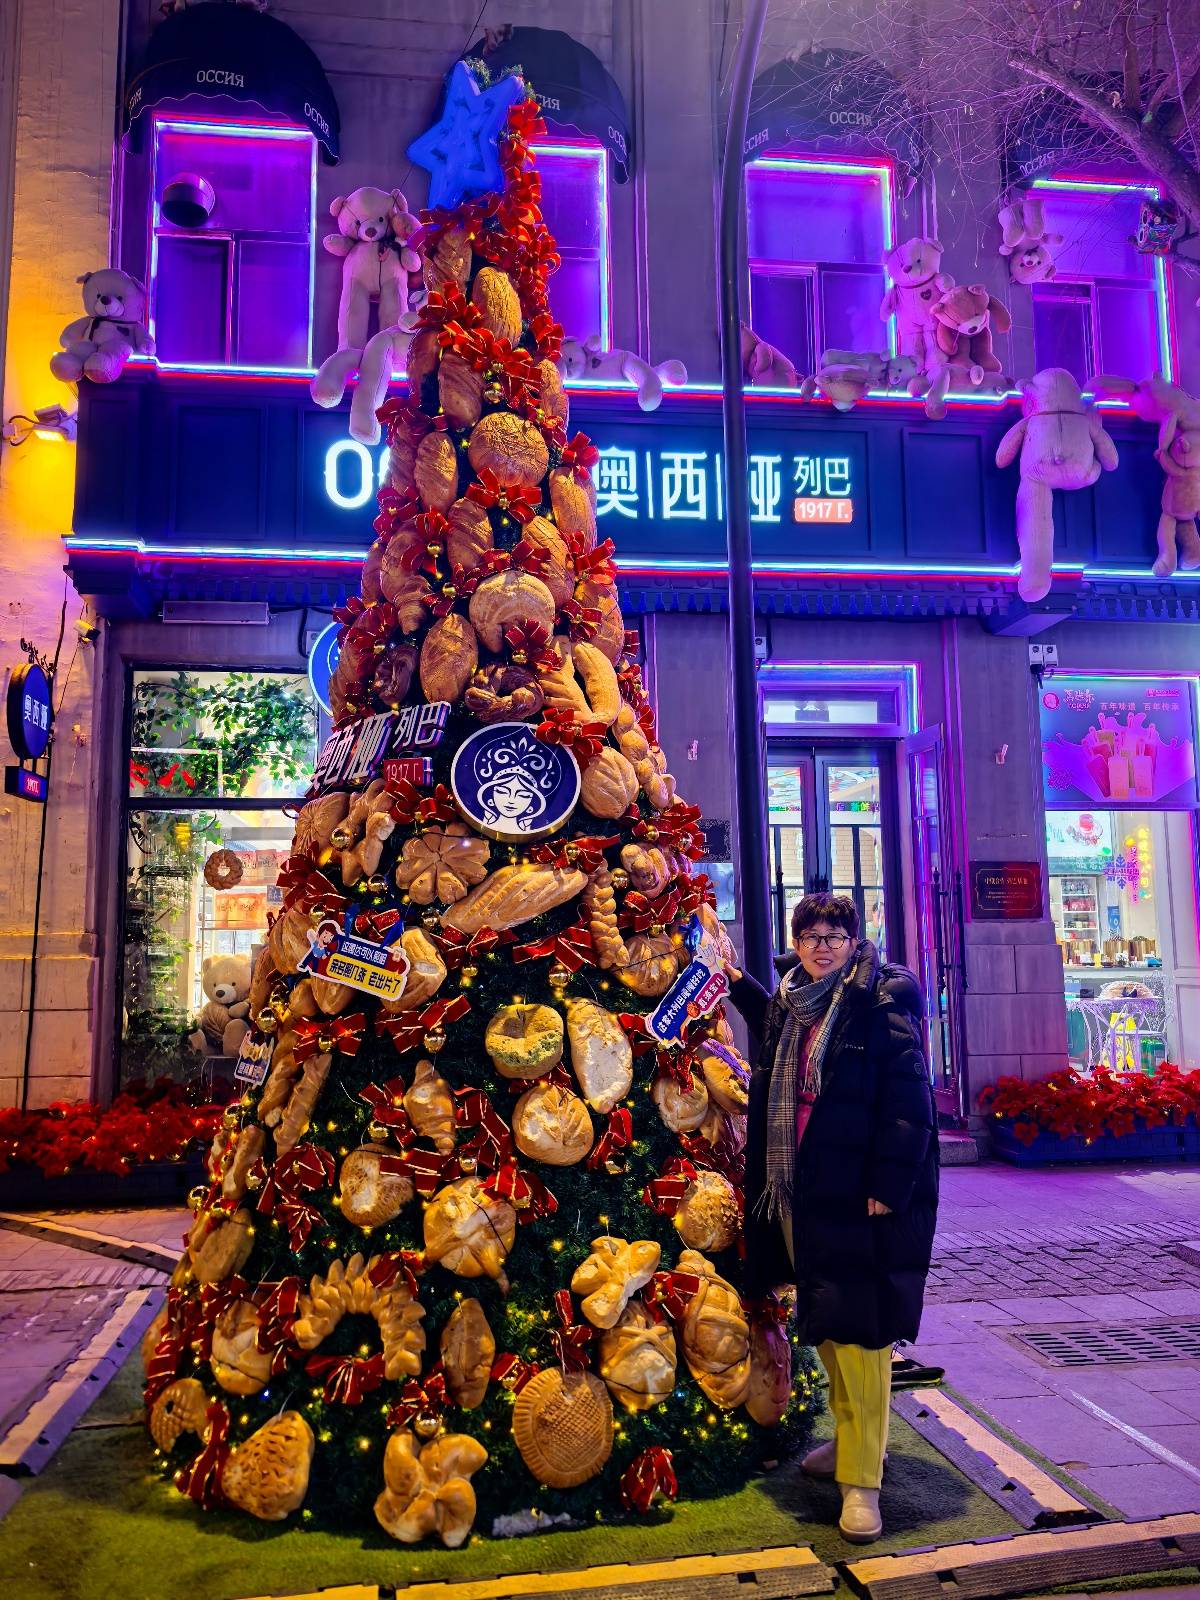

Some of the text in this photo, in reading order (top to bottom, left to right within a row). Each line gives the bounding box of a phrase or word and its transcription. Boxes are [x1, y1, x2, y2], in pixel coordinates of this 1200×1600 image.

[196, 69, 244, 88] ОССИЯ
[793, 456, 851, 496] 列巴
[799, 502, 832, 519] 1917
[392, 701, 450, 750] 列巴
[386, 763, 410, 782] 1917
